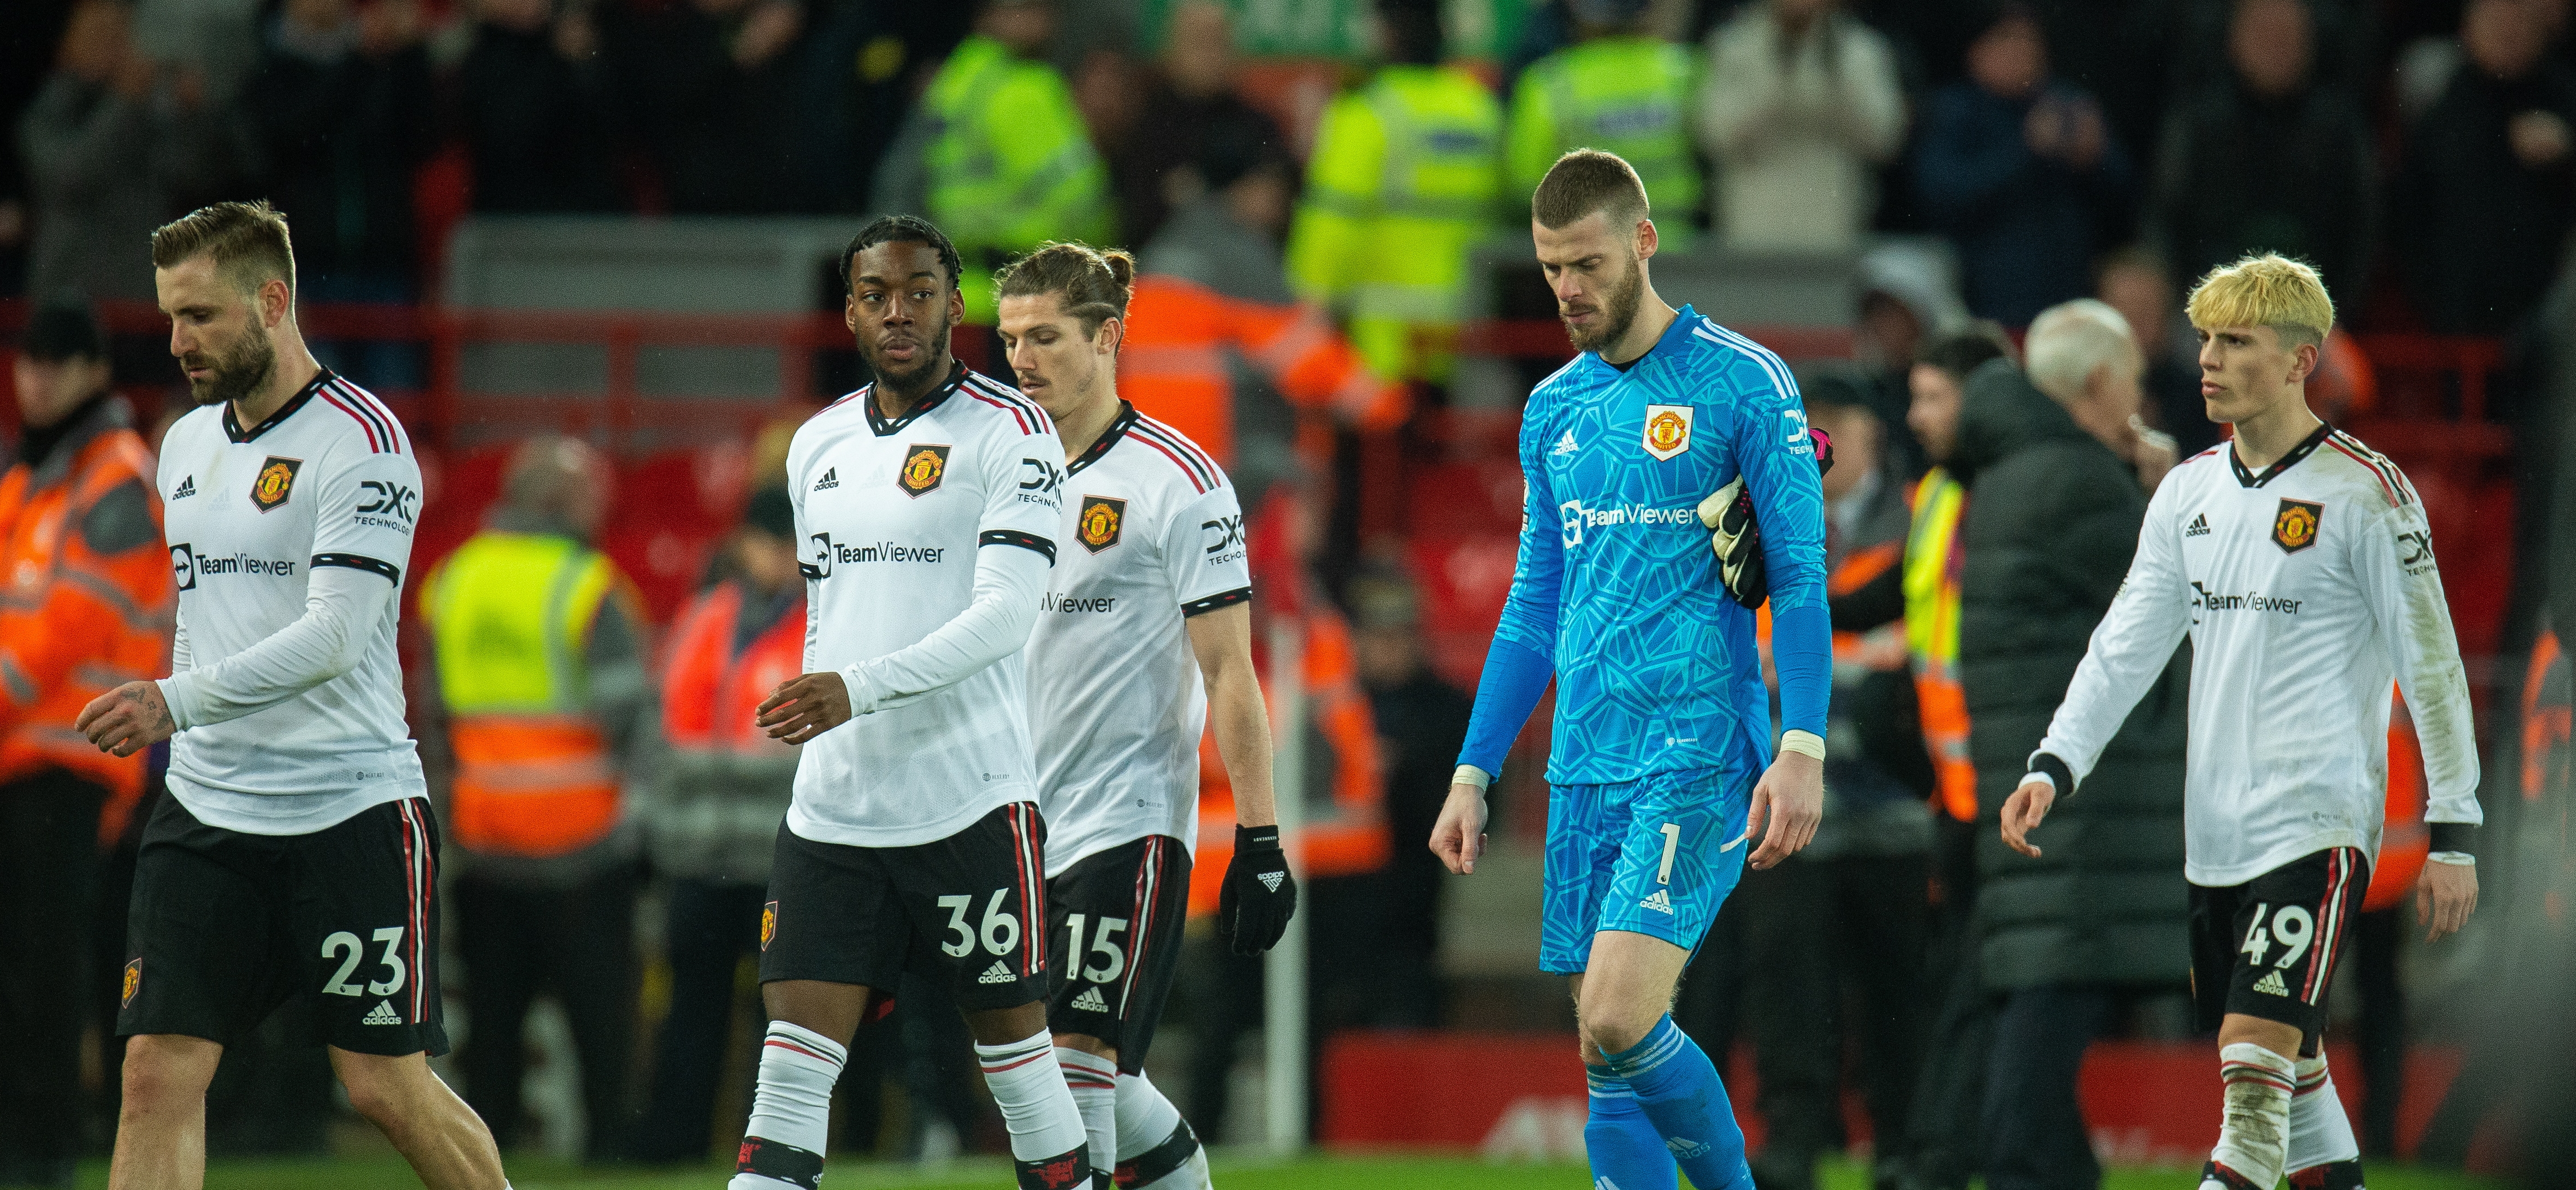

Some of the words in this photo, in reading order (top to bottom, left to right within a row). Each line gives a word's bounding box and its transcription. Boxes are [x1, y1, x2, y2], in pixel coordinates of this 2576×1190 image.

[1653, 414, 1683, 428] MANCHESTER
[1554, 443, 1578, 455] adidas
[814, 481, 839, 492] adidas
[173, 488, 196, 500] adidas
[357, 481, 415, 524] DXC
[1582, 504, 1697, 529] TeamViewer
[2186, 528, 2211, 536] adidas
[833, 541, 944, 564] TeamViewer
[195, 552, 295, 576] TeamViewer
[2203, 591, 2302, 615] TeamViewer
[1656, 822, 1681, 886] 1
[1257, 871, 1284, 880] adidas
[1639, 901, 1674, 915] adidas
[938, 887, 1020, 957] 36
[2241, 903, 2313, 969] 49
[1066, 914, 1128, 984] 15
[322, 926, 406, 997] 23
[978, 974, 1017, 984] adidas
[2253, 984, 2289, 997] adidas
[1071, 999, 1109, 1013] adidas
[362, 1015, 402, 1025] adidas
